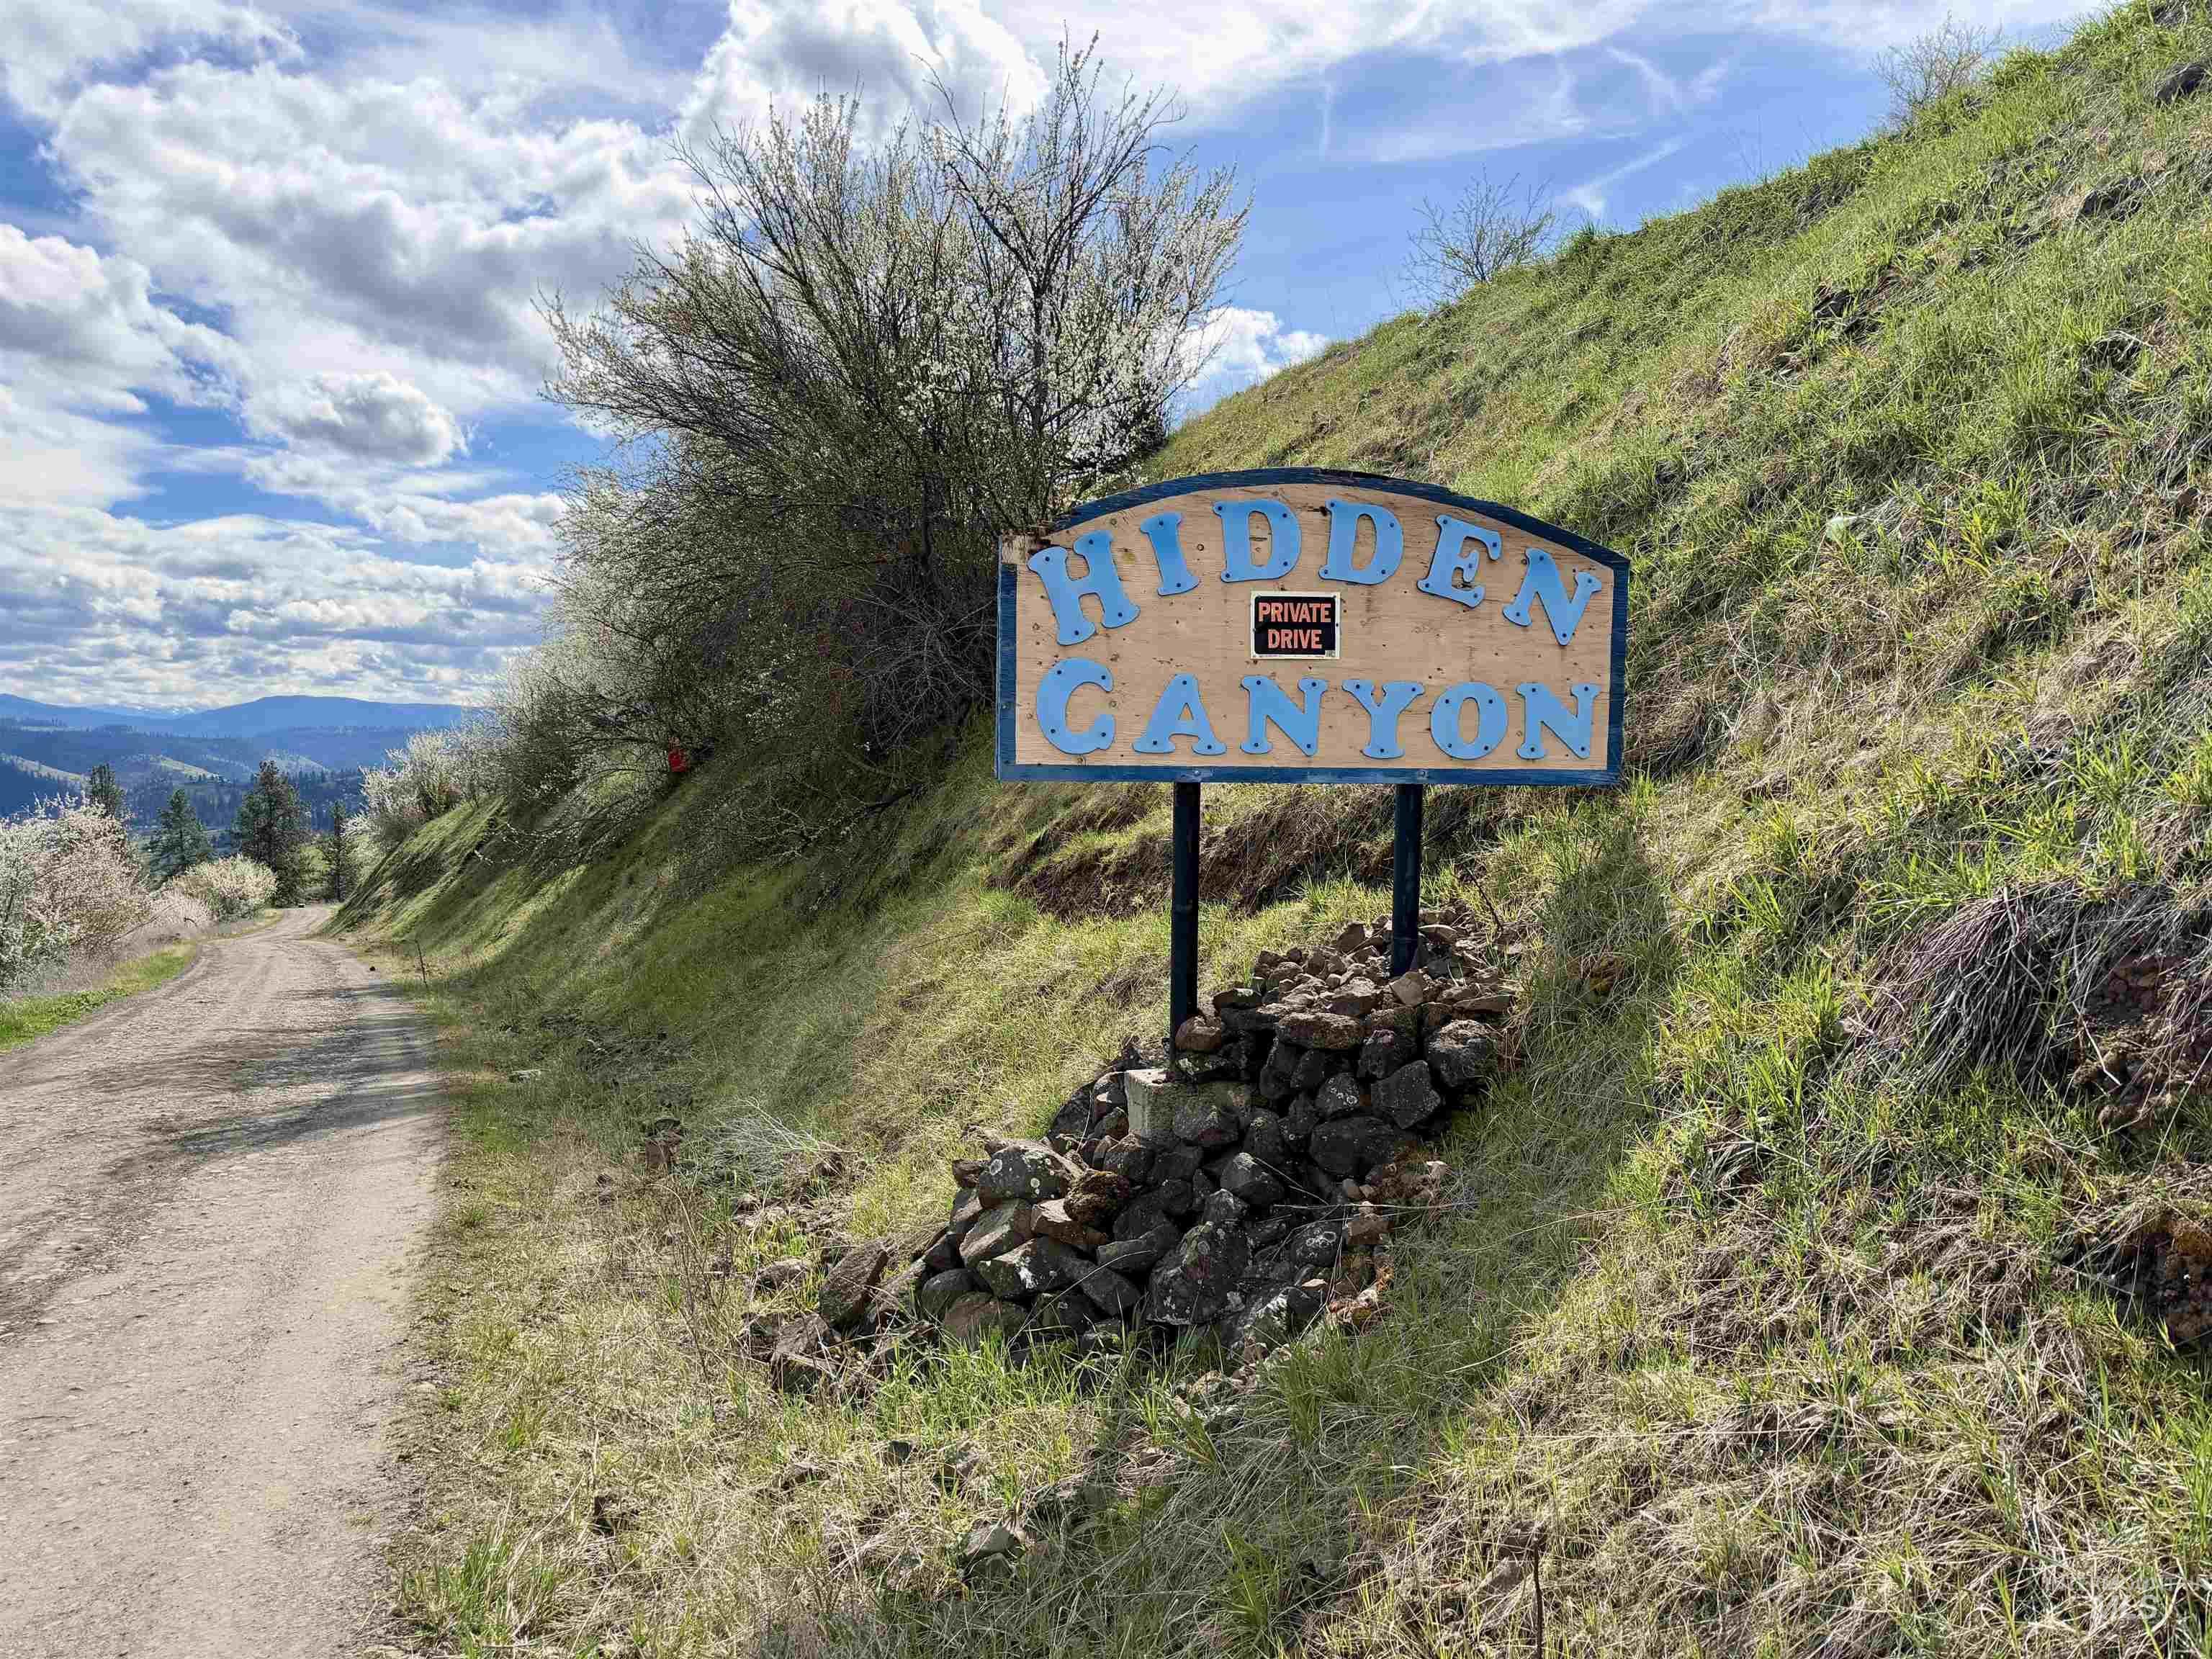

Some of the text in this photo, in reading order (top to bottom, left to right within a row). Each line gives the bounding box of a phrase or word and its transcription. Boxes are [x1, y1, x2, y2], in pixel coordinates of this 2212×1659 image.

[1026, 499, 1602, 646] HIDDEN
[1258, 602, 1331, 623] PRIVATE
[1267, 629, 1323, 649] DRIVE
[1035, 657, 1601, 760] CANYON
